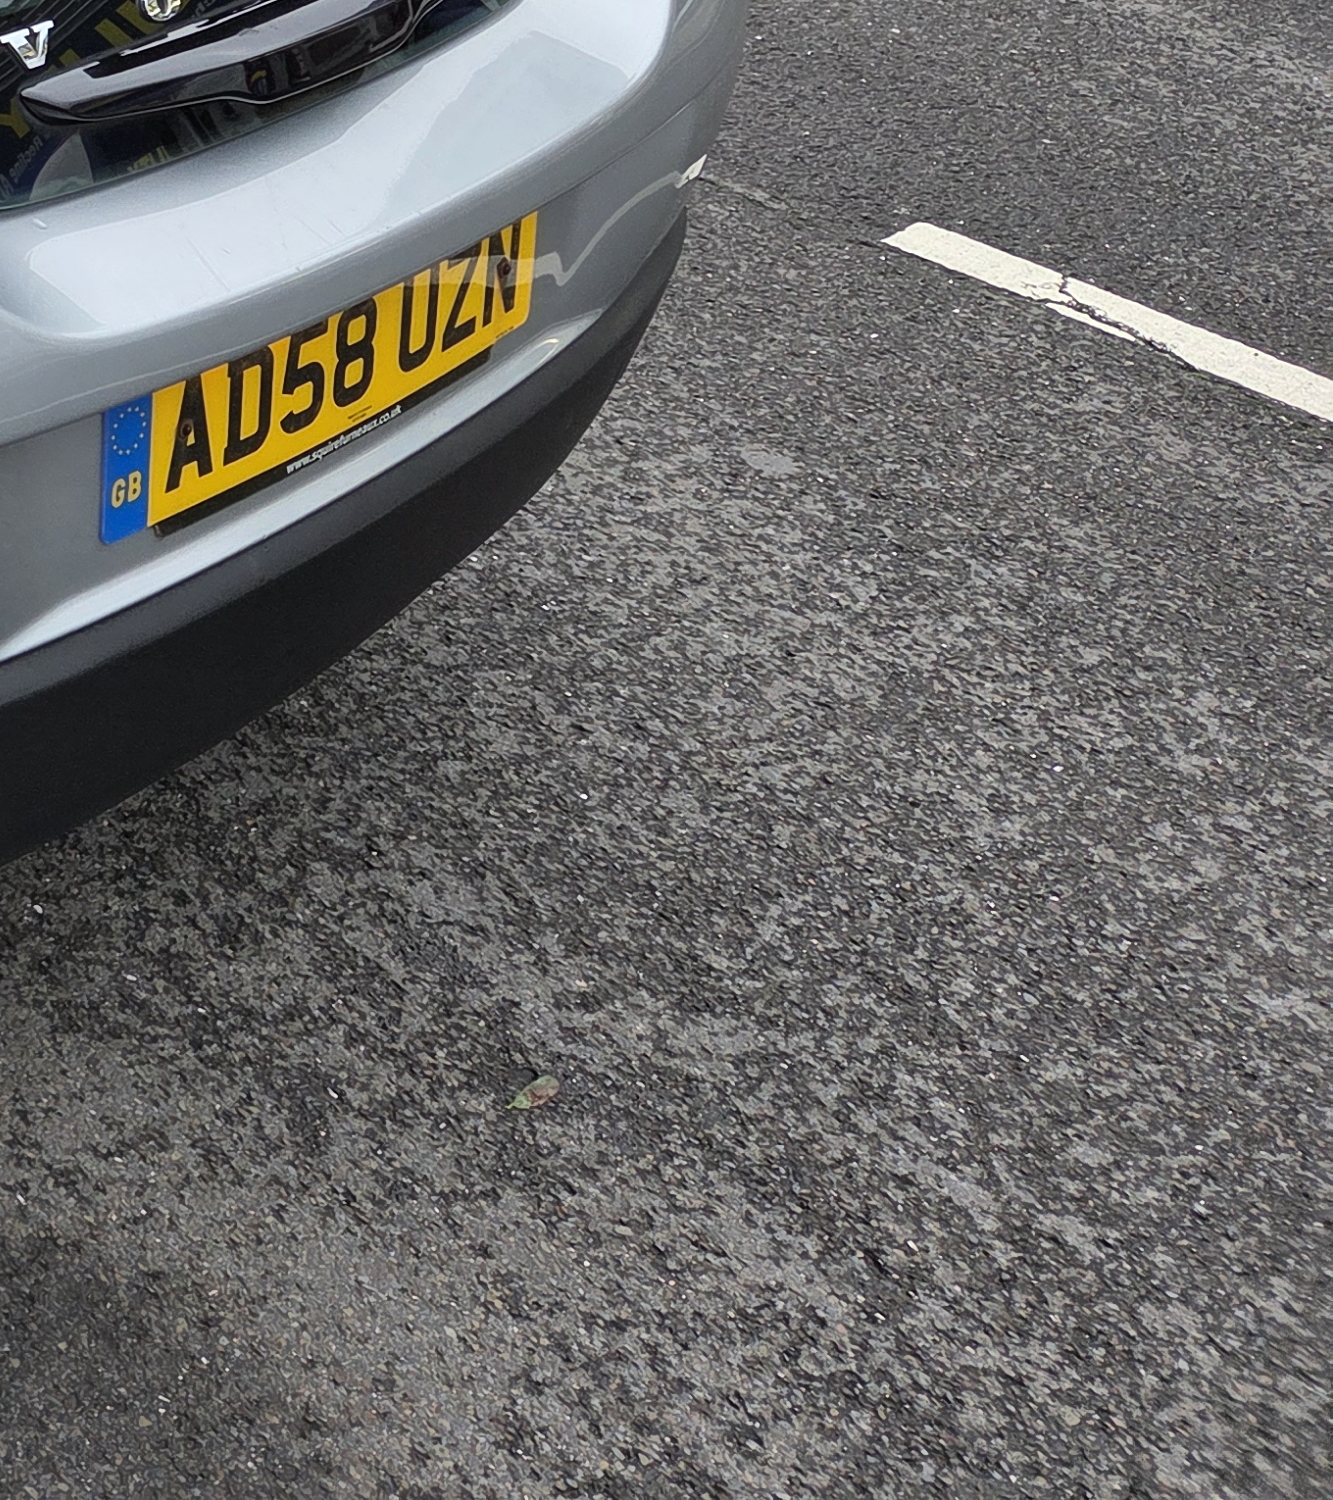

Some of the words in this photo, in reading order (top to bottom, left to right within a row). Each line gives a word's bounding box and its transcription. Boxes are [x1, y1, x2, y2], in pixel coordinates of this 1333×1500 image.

[164, 295, 378, 495] AD58
[397, 222, 524, 373] UZN
[110, 469, 143, 509] GB
